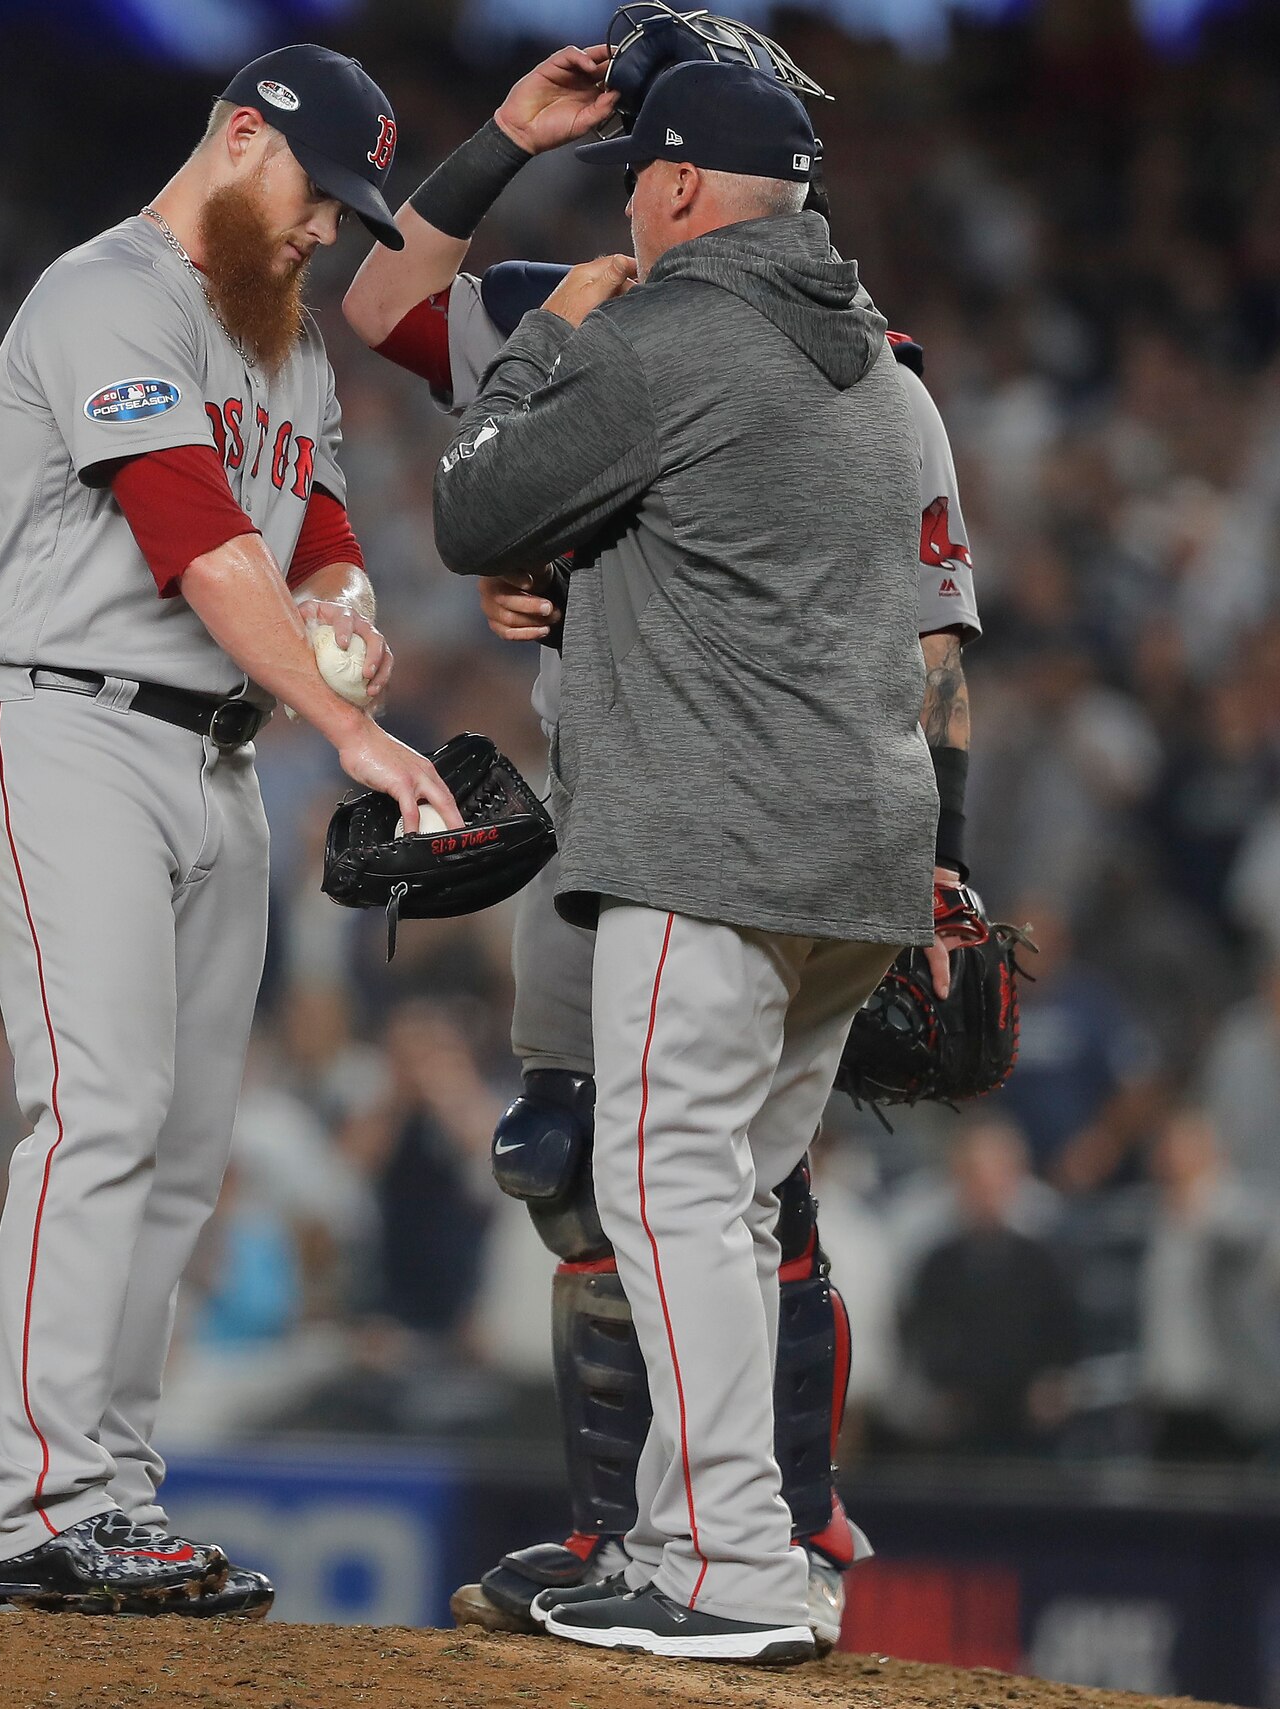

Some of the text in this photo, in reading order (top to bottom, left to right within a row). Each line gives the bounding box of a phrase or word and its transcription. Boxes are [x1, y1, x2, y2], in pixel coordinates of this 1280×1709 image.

[367, 114, 398, 170] B
[93, 395, 174, 417] POSTSEASON
[103, 392, 118, 401] 20
[205, 397, 317, 501] STON
